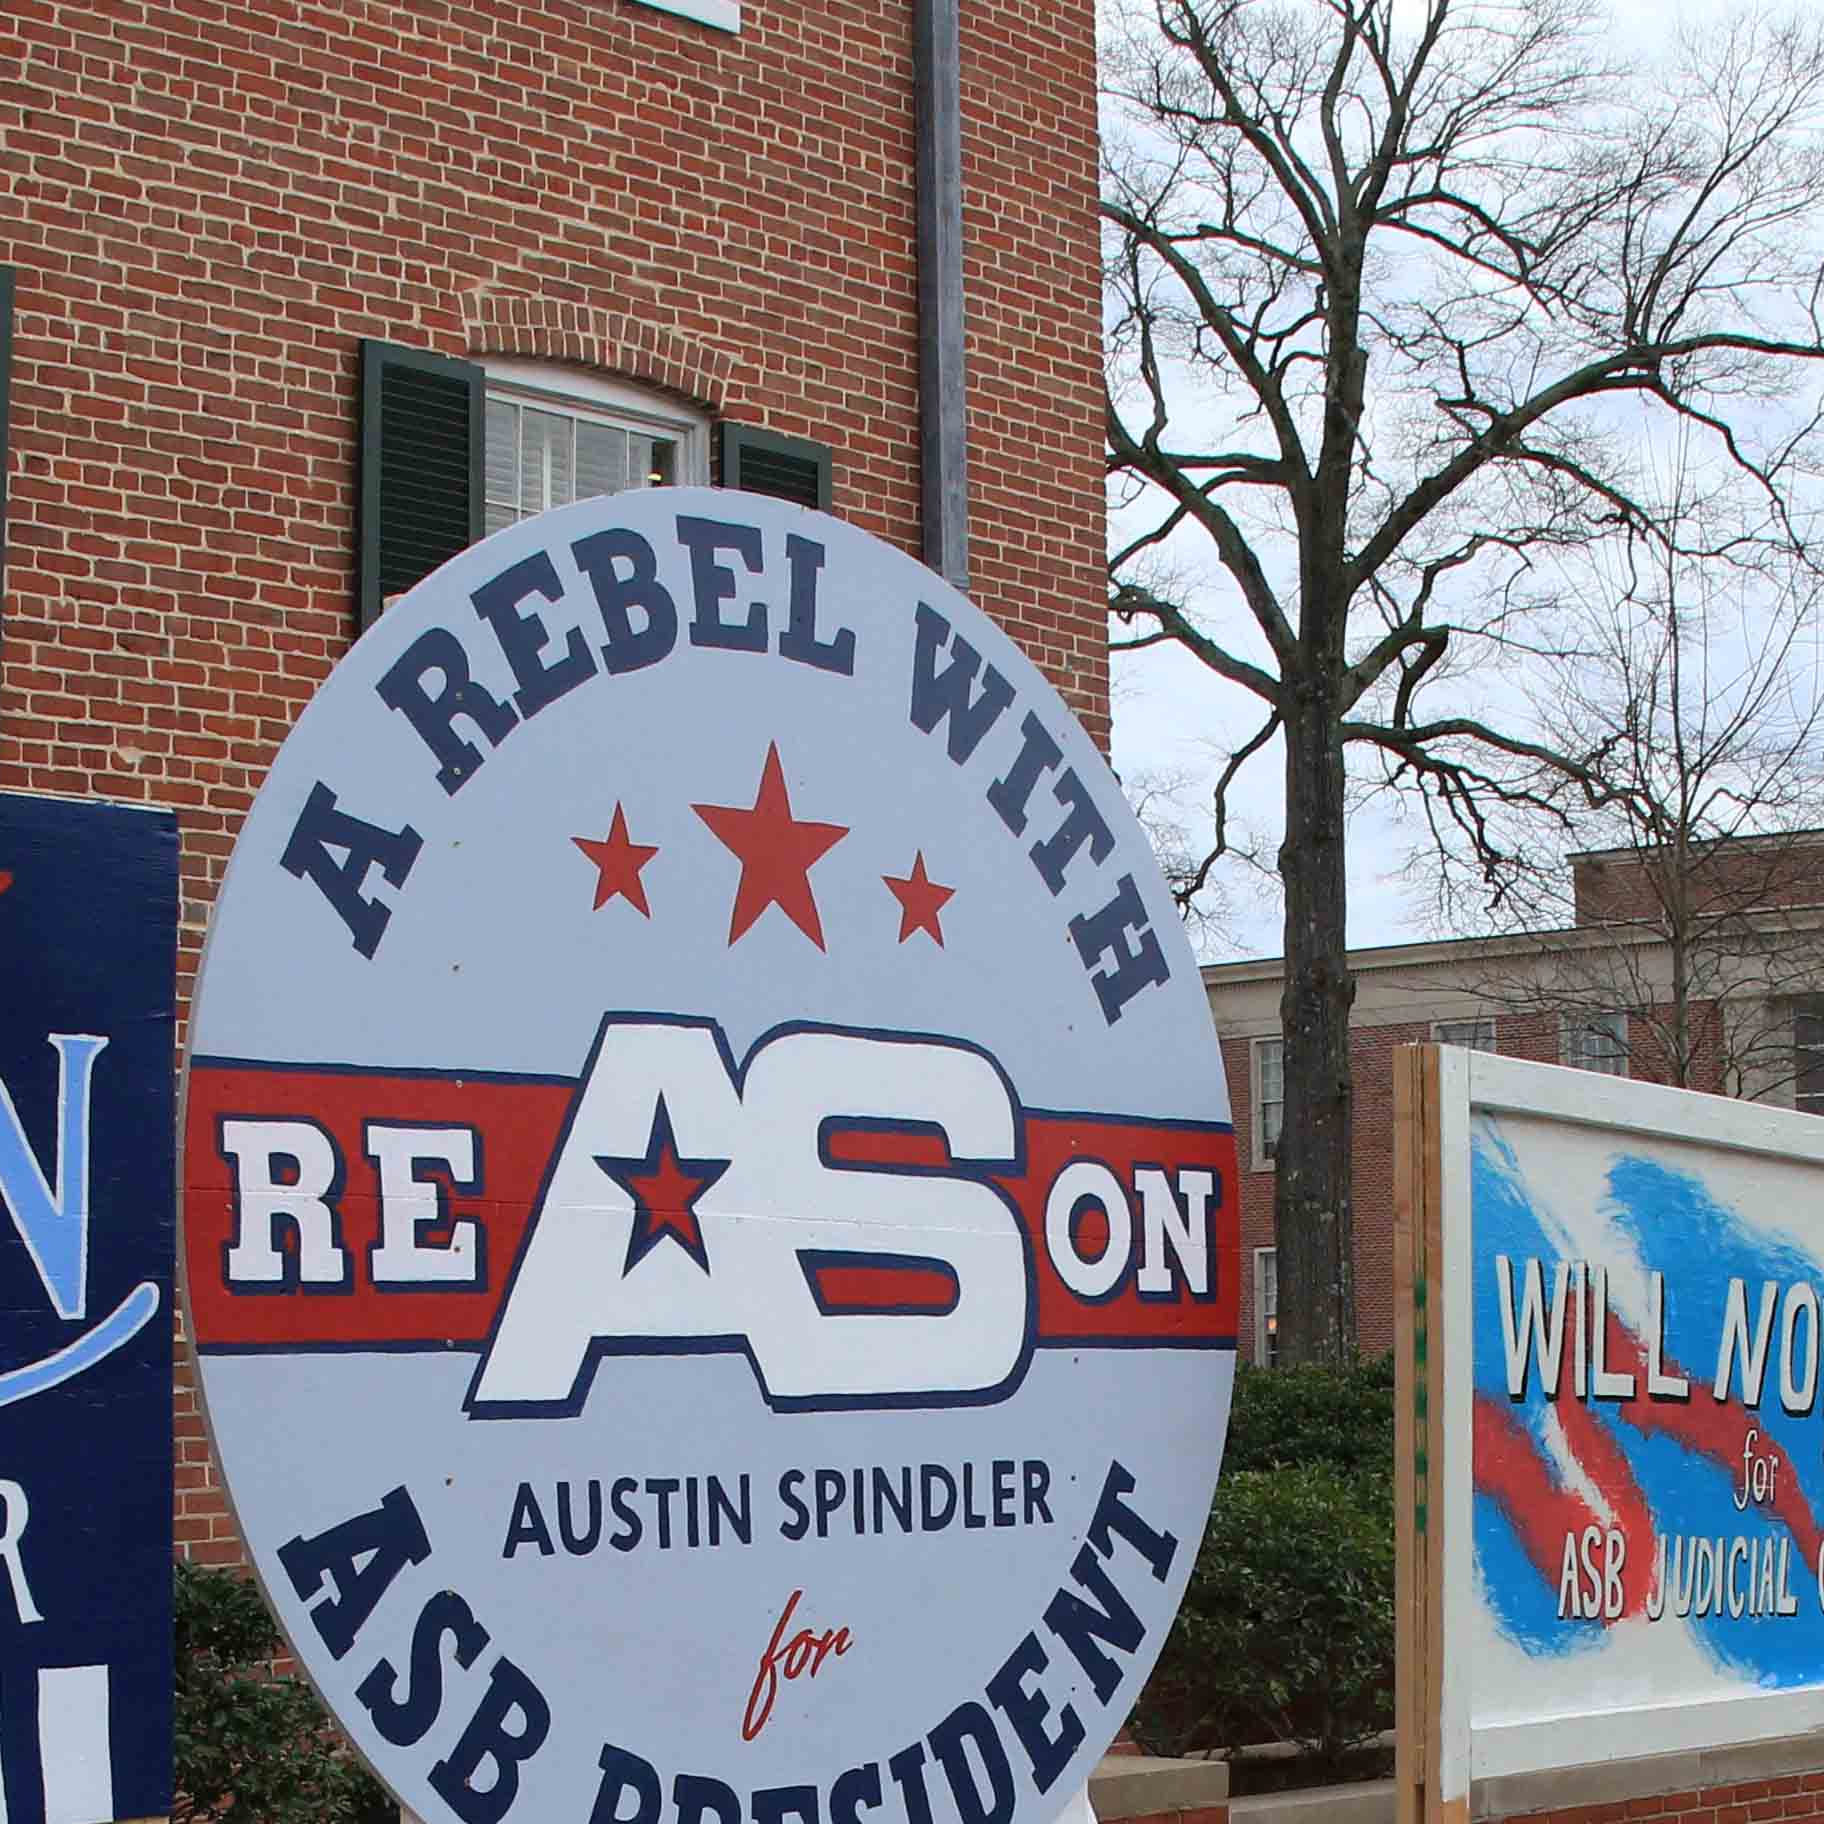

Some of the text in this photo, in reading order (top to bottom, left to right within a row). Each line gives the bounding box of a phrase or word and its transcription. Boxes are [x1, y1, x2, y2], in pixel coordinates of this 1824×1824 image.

[277, 513, 1171, 1025] A REBEL WITH
[1495, 1254, 1689, 1402] WILL
[502, 1458, 1056, 1560] AUSTIN SPINDLER
[1734, 1429, 1779, 1511] for
[1557, 1525, 1628, 1622] ASB
[1646, 1530, 1799, 1622] JUDICIAL
[740, 1587, 856, 1742] for
